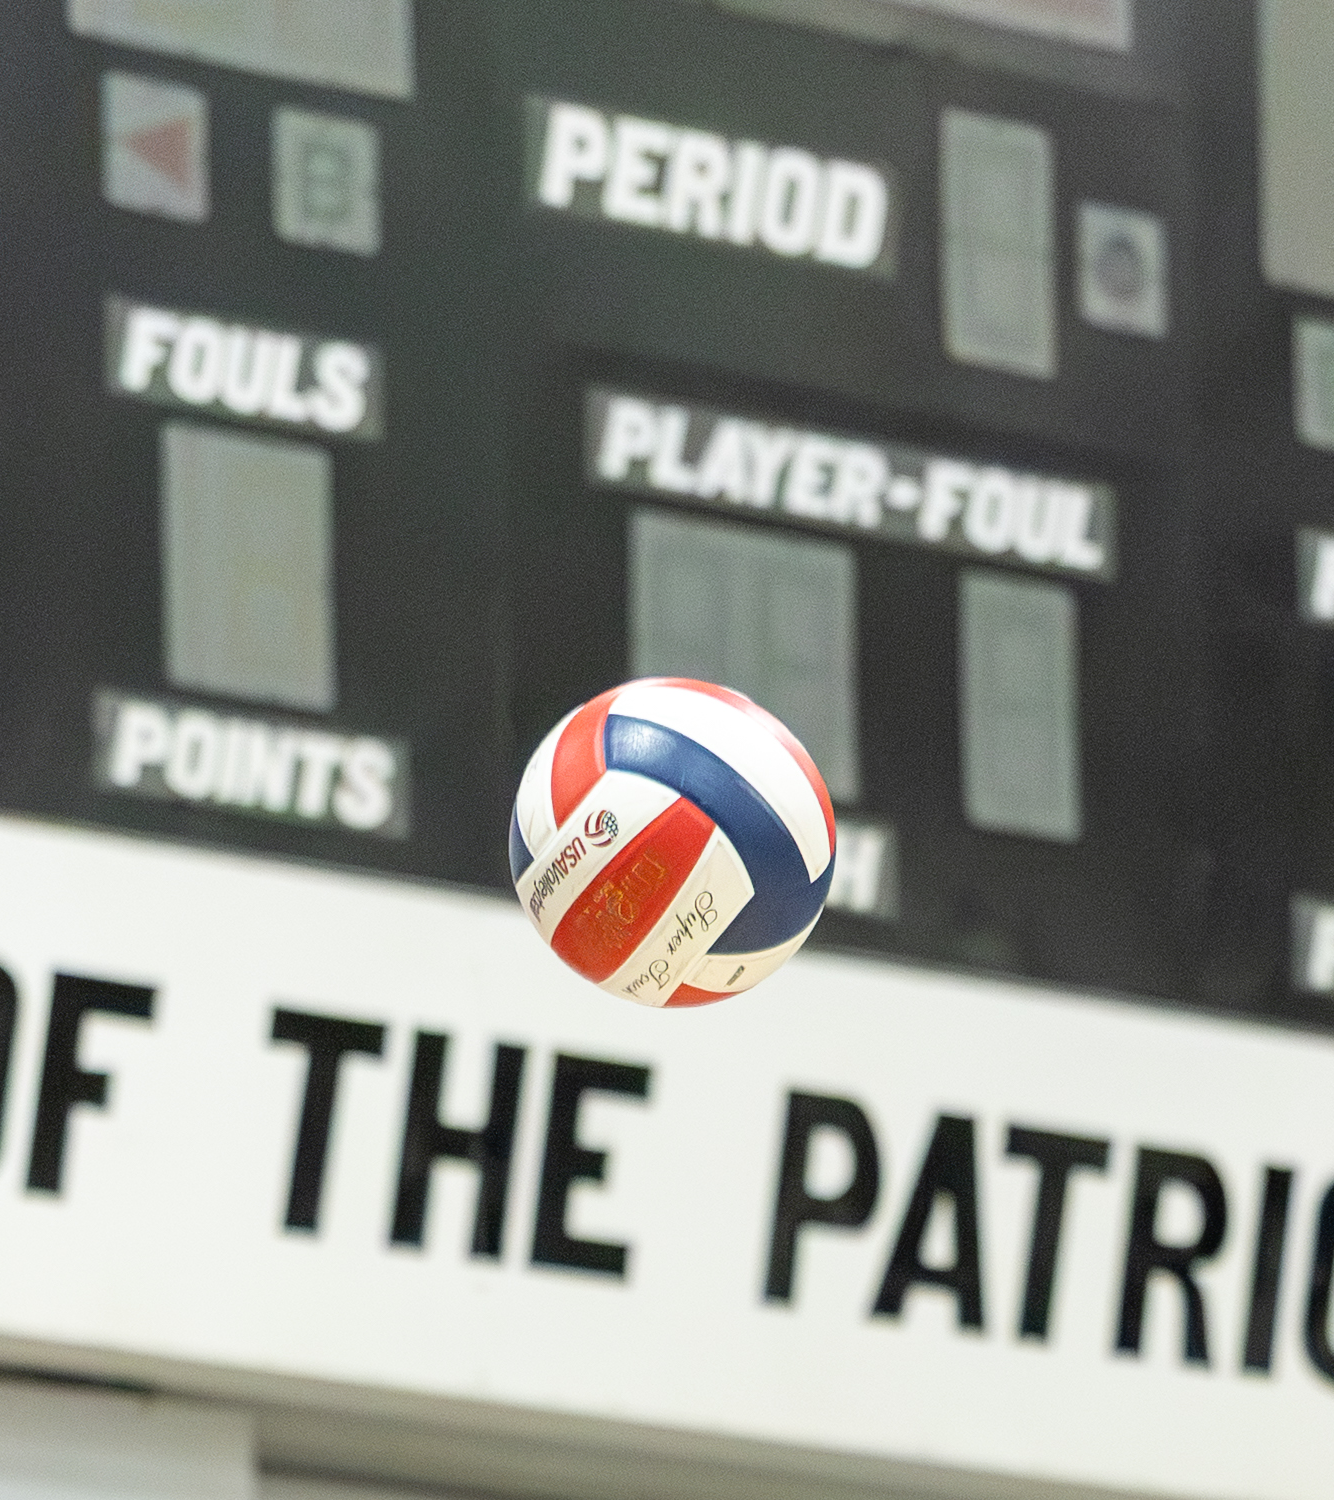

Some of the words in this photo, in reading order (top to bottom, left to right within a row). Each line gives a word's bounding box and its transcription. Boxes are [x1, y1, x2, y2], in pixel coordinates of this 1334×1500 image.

[539, 101, 888, 269] PERIOD
[119, 306, 368, 433] FOULS
[597, 397, 1104, 571] PLAYER-FOUL
[110, 704, 395, 831] POINTS
[666, 890, 718, 955] Super
[267, 1008, 652, 1283] THE
